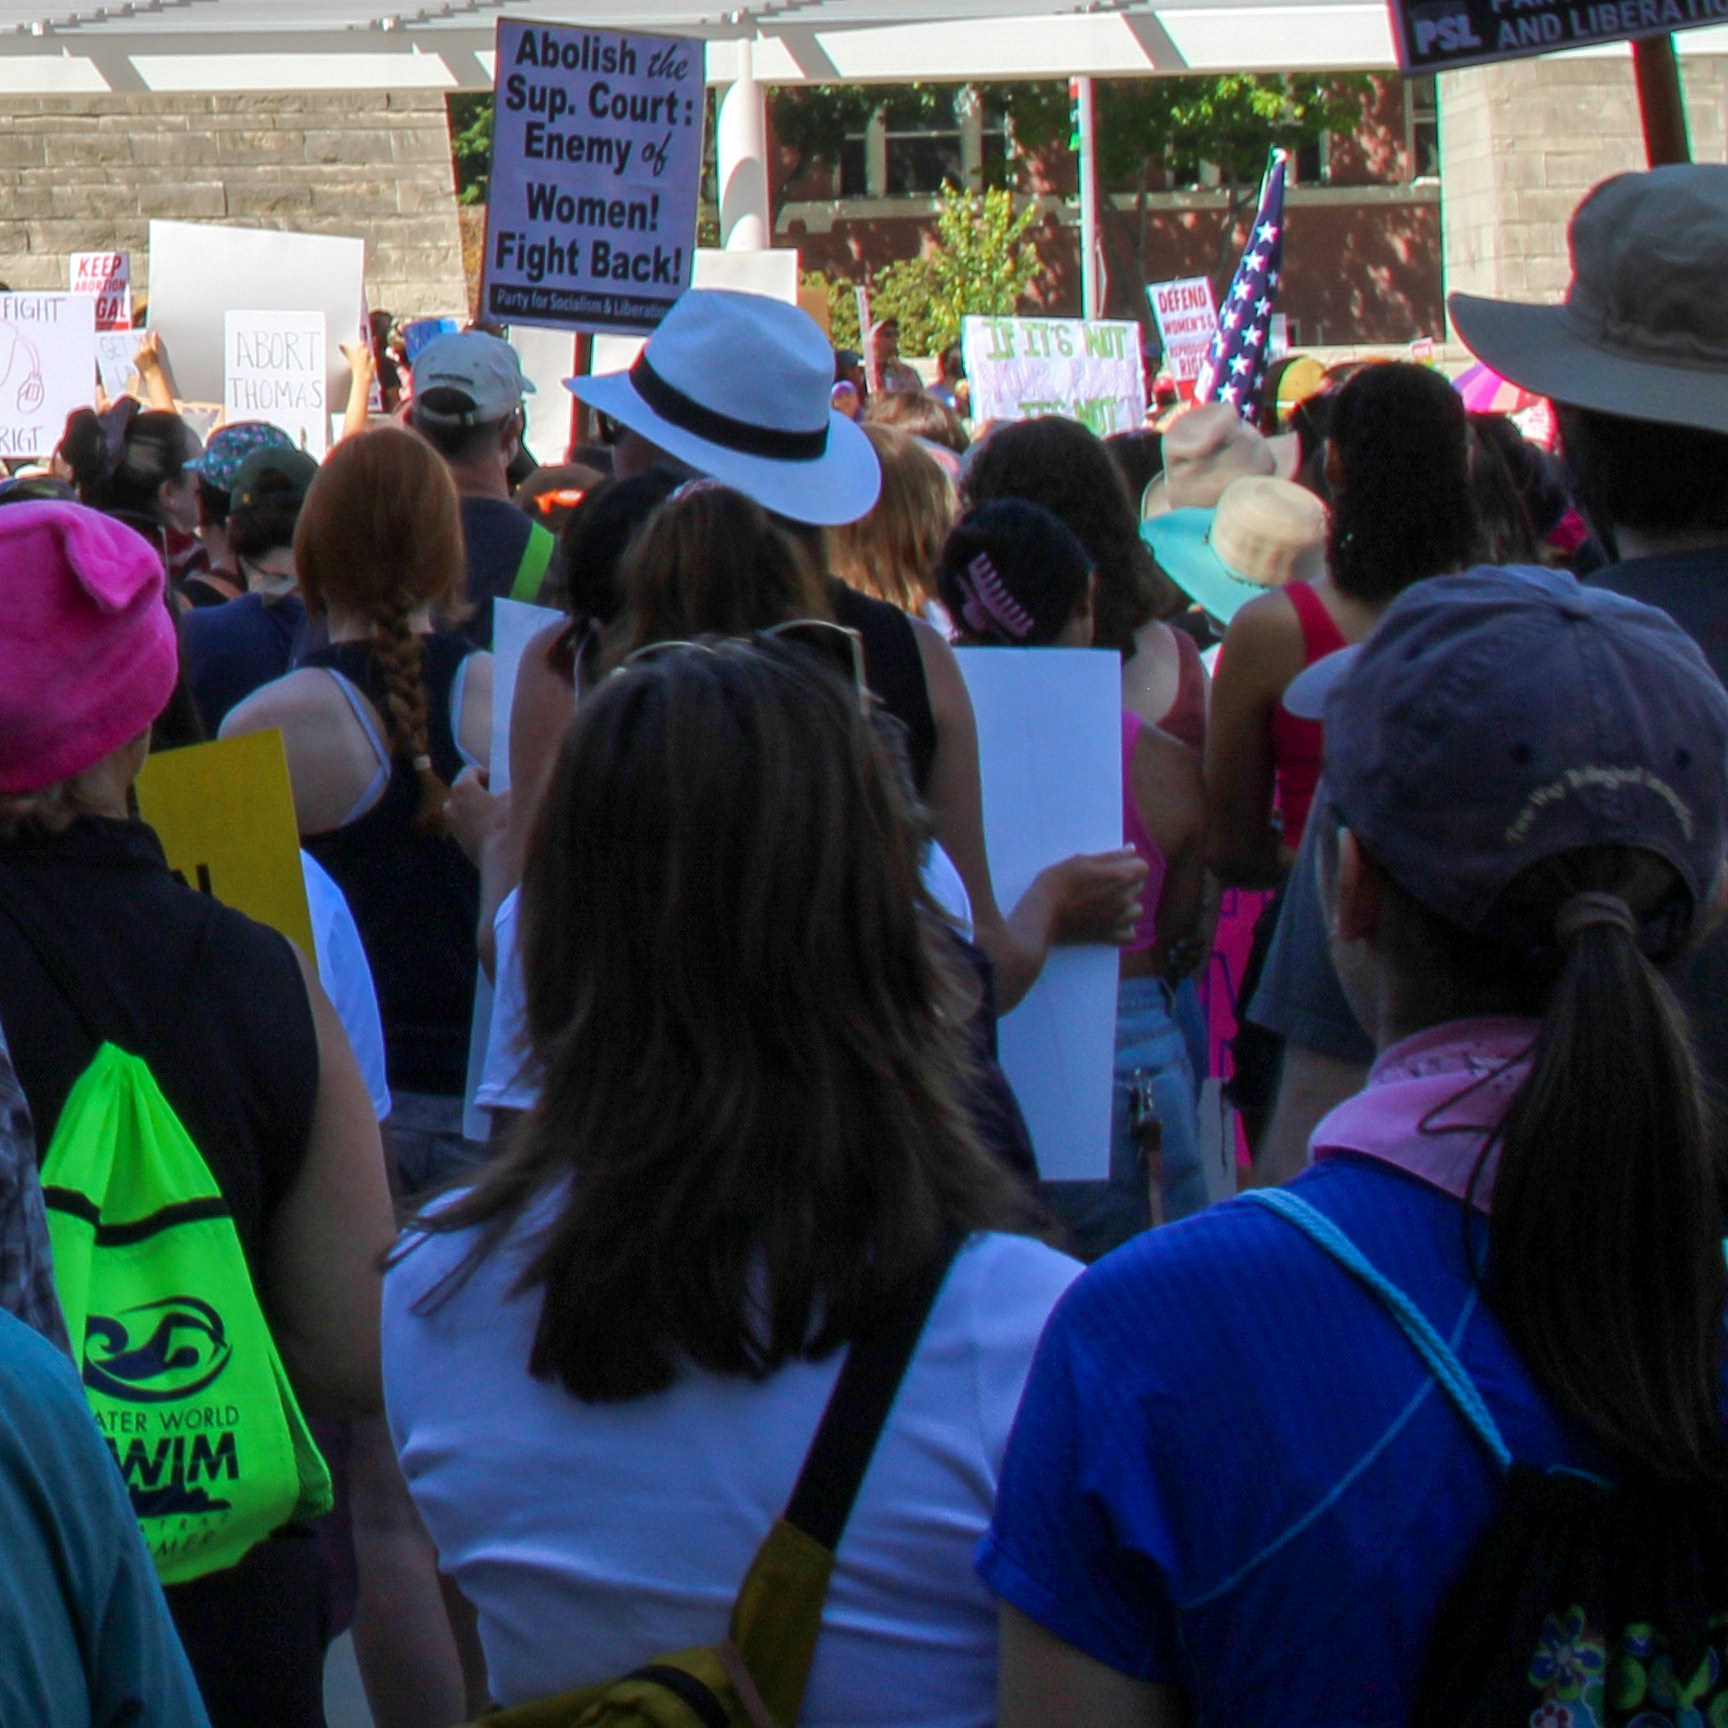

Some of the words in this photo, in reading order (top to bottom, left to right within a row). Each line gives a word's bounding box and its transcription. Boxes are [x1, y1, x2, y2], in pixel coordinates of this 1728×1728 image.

[1413, 13, 1481, 55] PSL
[1497, 12, 1563, 51] AND
[515, 29, 636, 76] Abolish
[647, 43, 688, 82] the
[505, 73, 575, 122] Sup.
[524, 121, 632, 176] Enemy
[641, 131, 672, 177] of
[526, 181, 659, 232] Women!
[78, 255, 122, 278] KEEP
[496, 230, 579, 283] Fight
[590, 239, 682, 285] Back!
[74, 278, 126, 293] ABORTION
[497, 288, 529, 311] Party
[531, 291, 548, 307] for
[550, 293, 602, 311] Socialism
[1157, 284, 1208, 314] DEFEND
[3, 297, 66, 322] FIGHT
[95, 296, 127, 320] GAL
[236, 331, 321, 371] ABORT
[982, 318, 1015, 359] IF
[1083, 324, 1127, 359] NOT
[228, 377, 323, 410] THOMAS
[93, 1410, 148, 1433] ATER
[159, 1405, 240, 1431] WORLD
[105, 1432, 240, 1486] WIM
